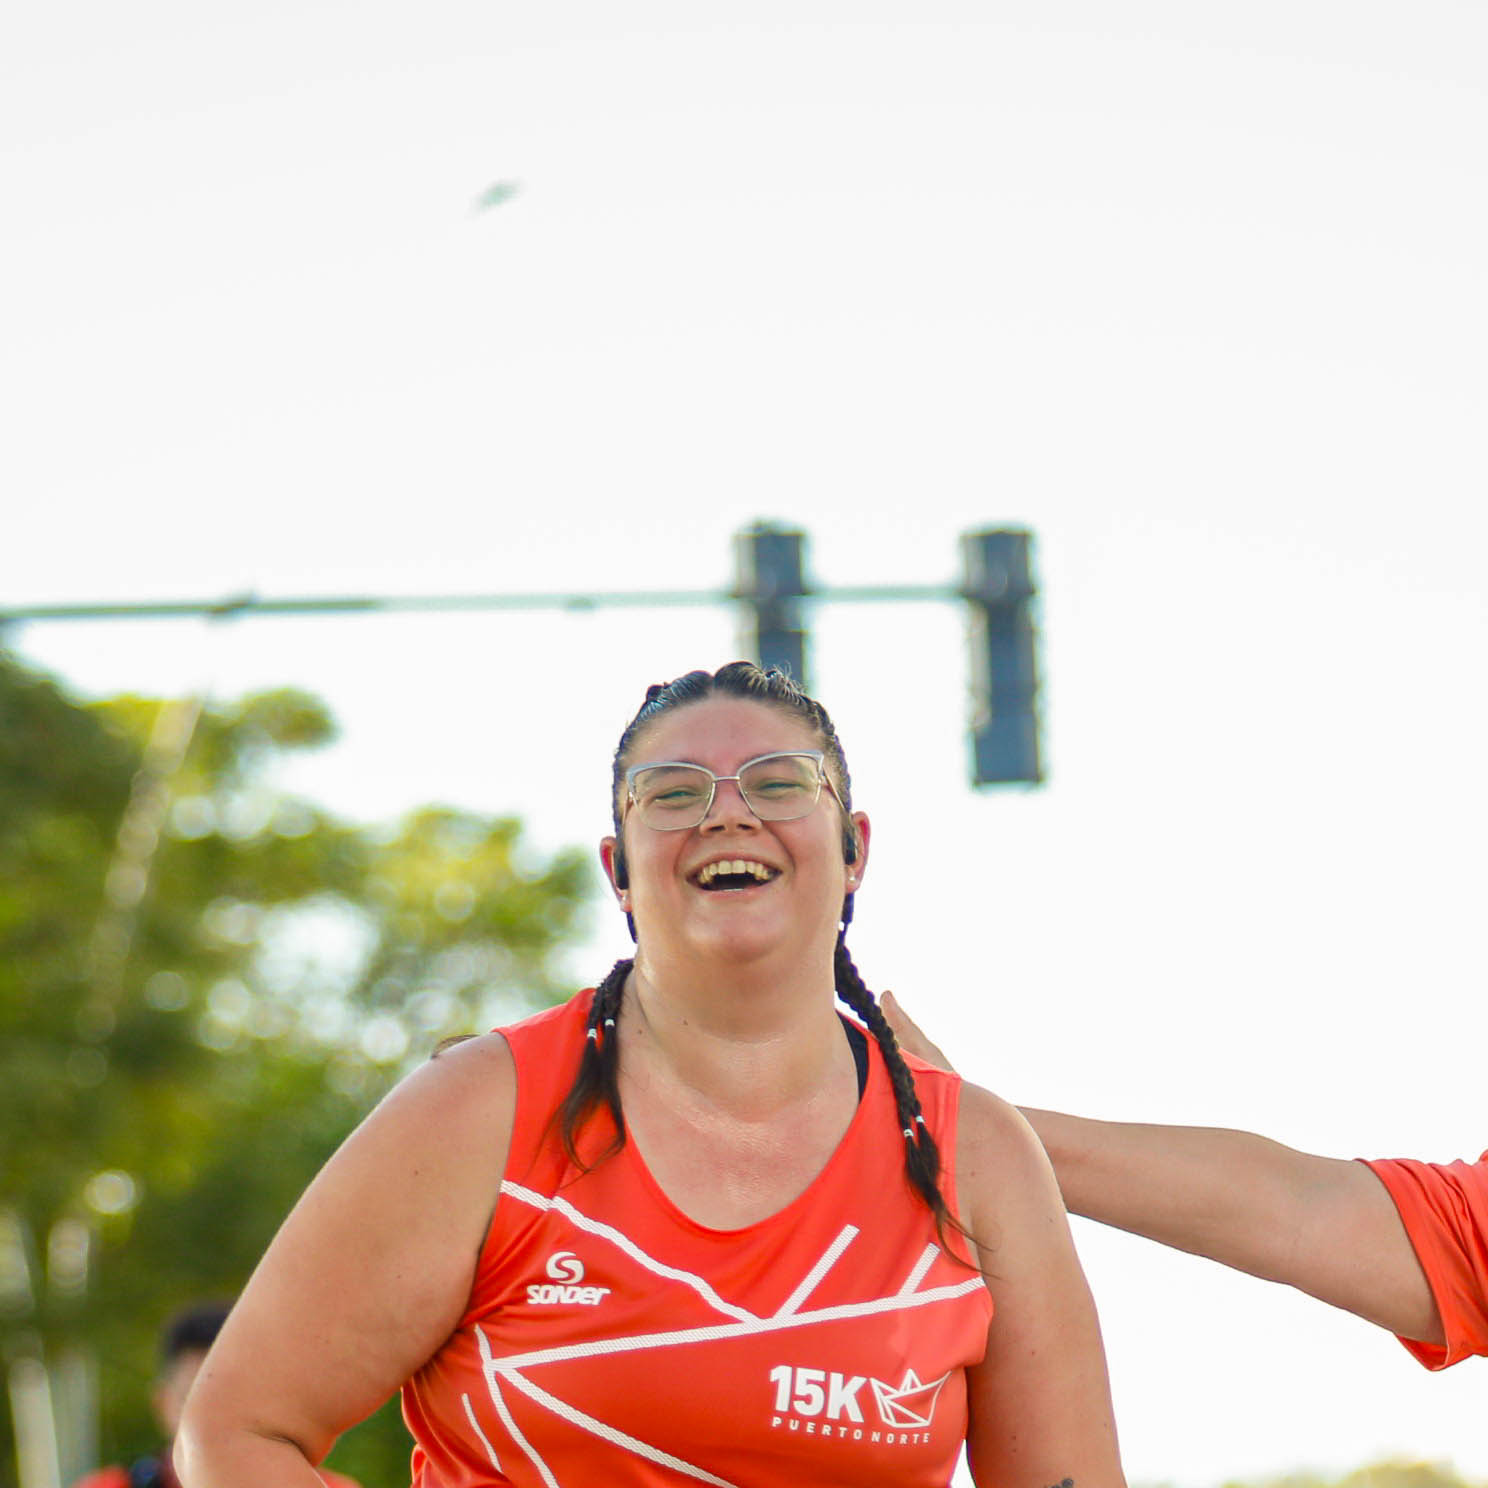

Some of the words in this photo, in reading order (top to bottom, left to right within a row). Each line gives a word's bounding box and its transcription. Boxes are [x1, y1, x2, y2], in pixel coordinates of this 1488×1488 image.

[769, 1365, 867, 1423] 15K
[771, 1416, 862, 1441] PUERTO
[871, 1431, 931, 1445] NORTE
